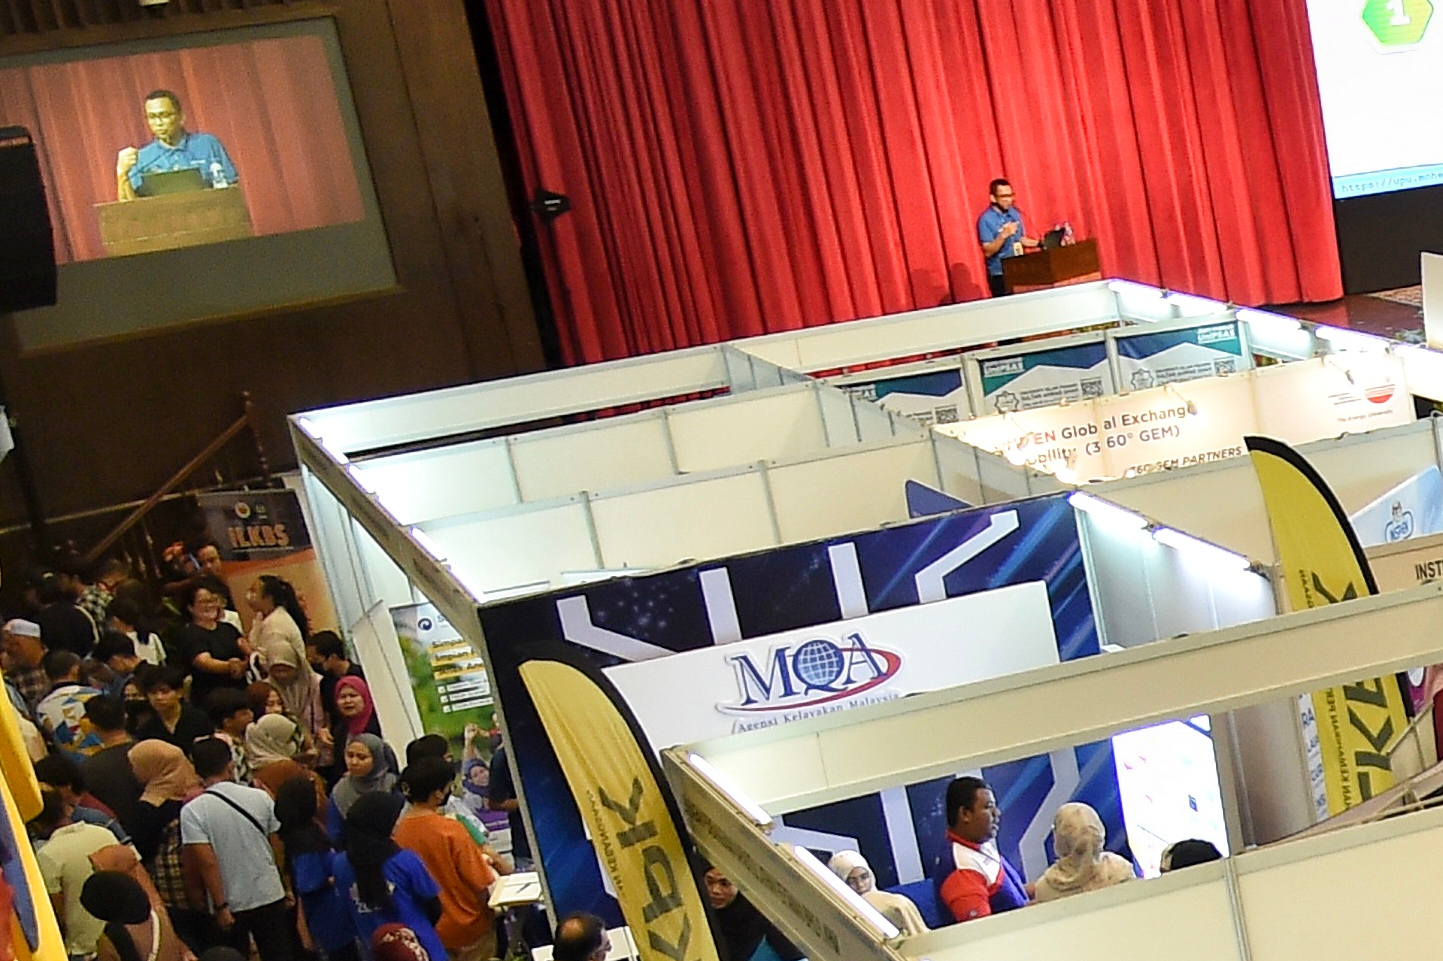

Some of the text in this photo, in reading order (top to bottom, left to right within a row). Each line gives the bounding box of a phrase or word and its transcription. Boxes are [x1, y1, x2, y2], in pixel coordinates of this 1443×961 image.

[1138, 425, 1180, 445] GEM)
[1182, 446, 1242, 466] PARTNERS
[731, 633, 887, 706] MQA
[738, 693, 899, 731] Agensi Kelayakan Malaysia
